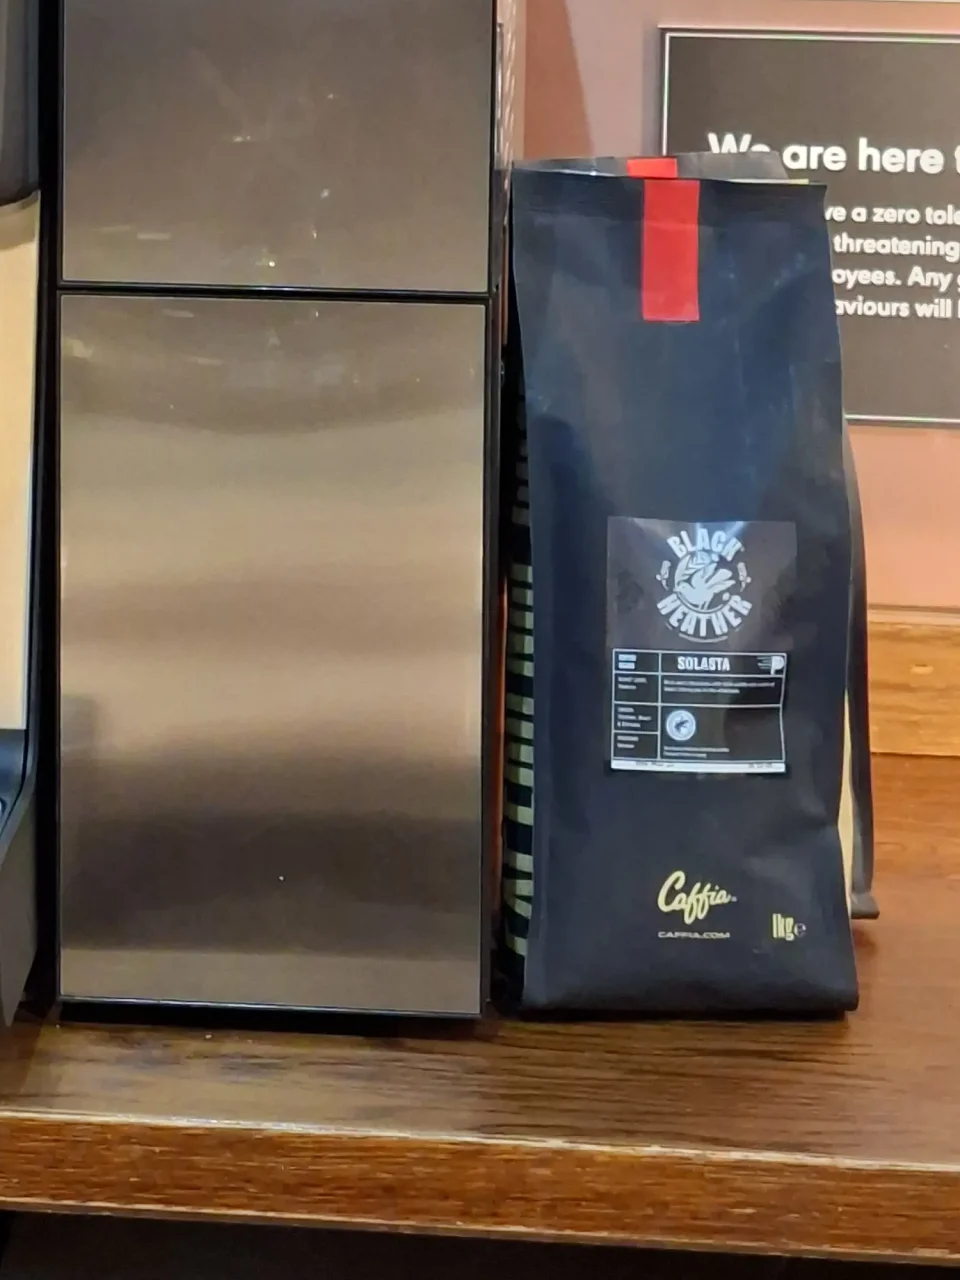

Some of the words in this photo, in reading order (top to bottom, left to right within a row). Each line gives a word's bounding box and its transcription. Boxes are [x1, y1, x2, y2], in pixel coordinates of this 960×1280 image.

[782, 144, 847, 171] are
[858, 137, 944, 174] here
[851, 207, 867, 223] a
[872, 207, 921, 225] zero
[833, 231, 960, 263] threatening
[907, 265, 954, 293] Any
[914, 298, 953, 319] will
[666, 528, 743, 562] BLACK
[656, 593, 753, 637] HEATHER
[677, 656, 731, 672] SOLASTA
[657, 871, 732, 925] Caffia
